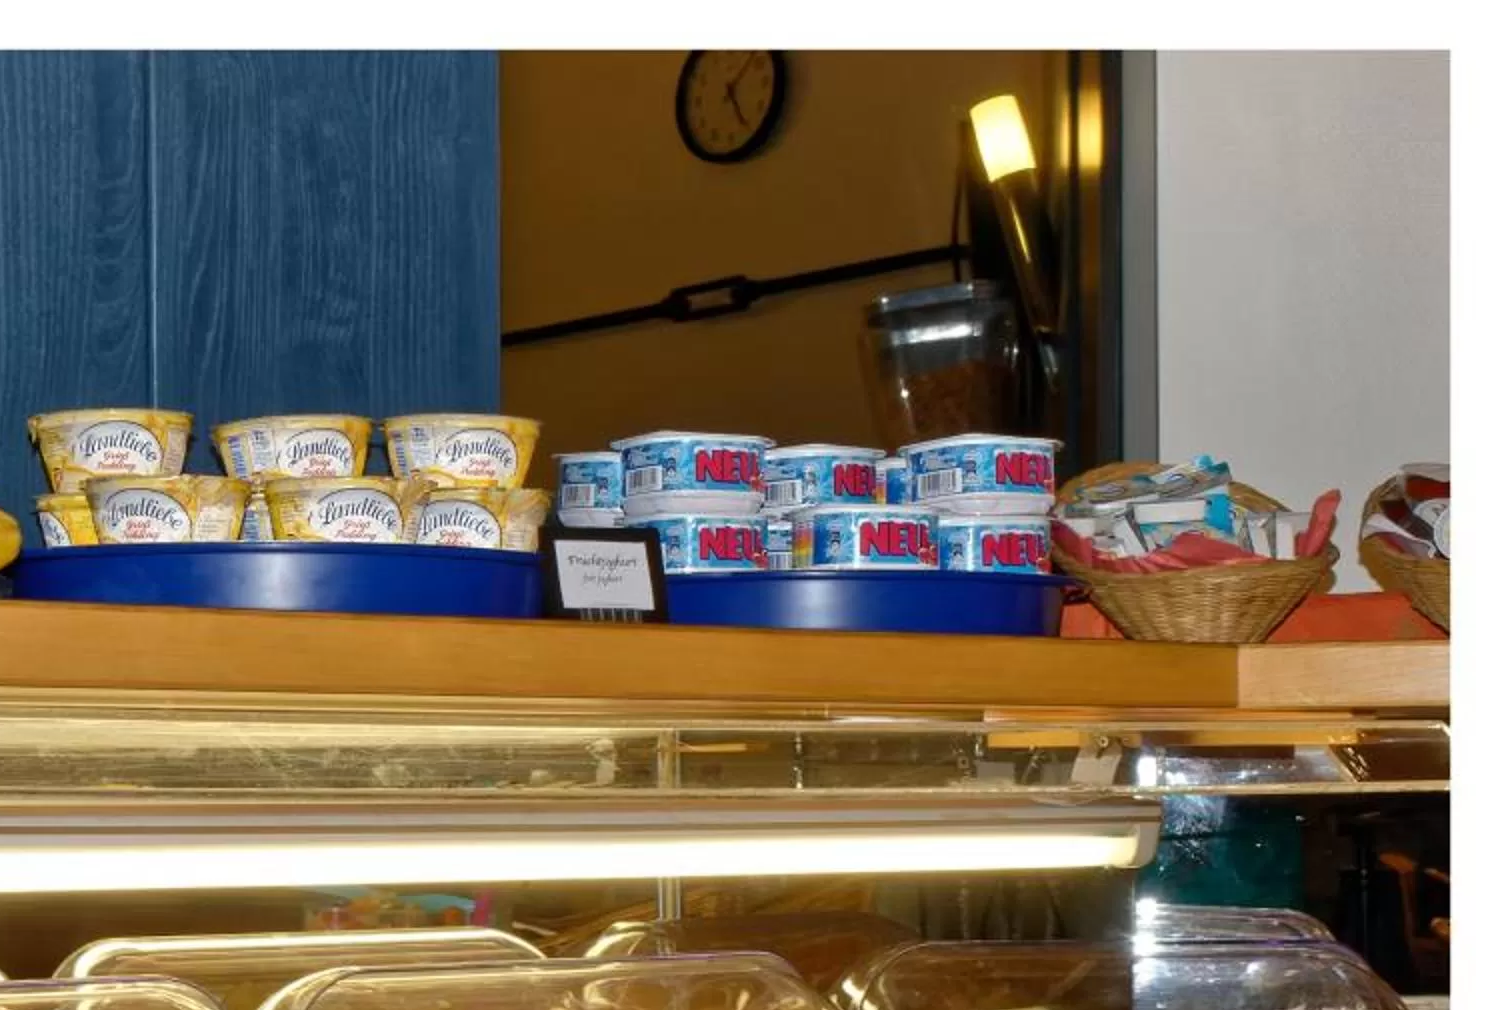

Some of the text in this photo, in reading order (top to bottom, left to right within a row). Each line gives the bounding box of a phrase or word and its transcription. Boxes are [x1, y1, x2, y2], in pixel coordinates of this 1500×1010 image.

[695, 448, 760, 484] NEU
[698, 526, 764, 561] NEU
[859, 520, 930, 557] NEU
